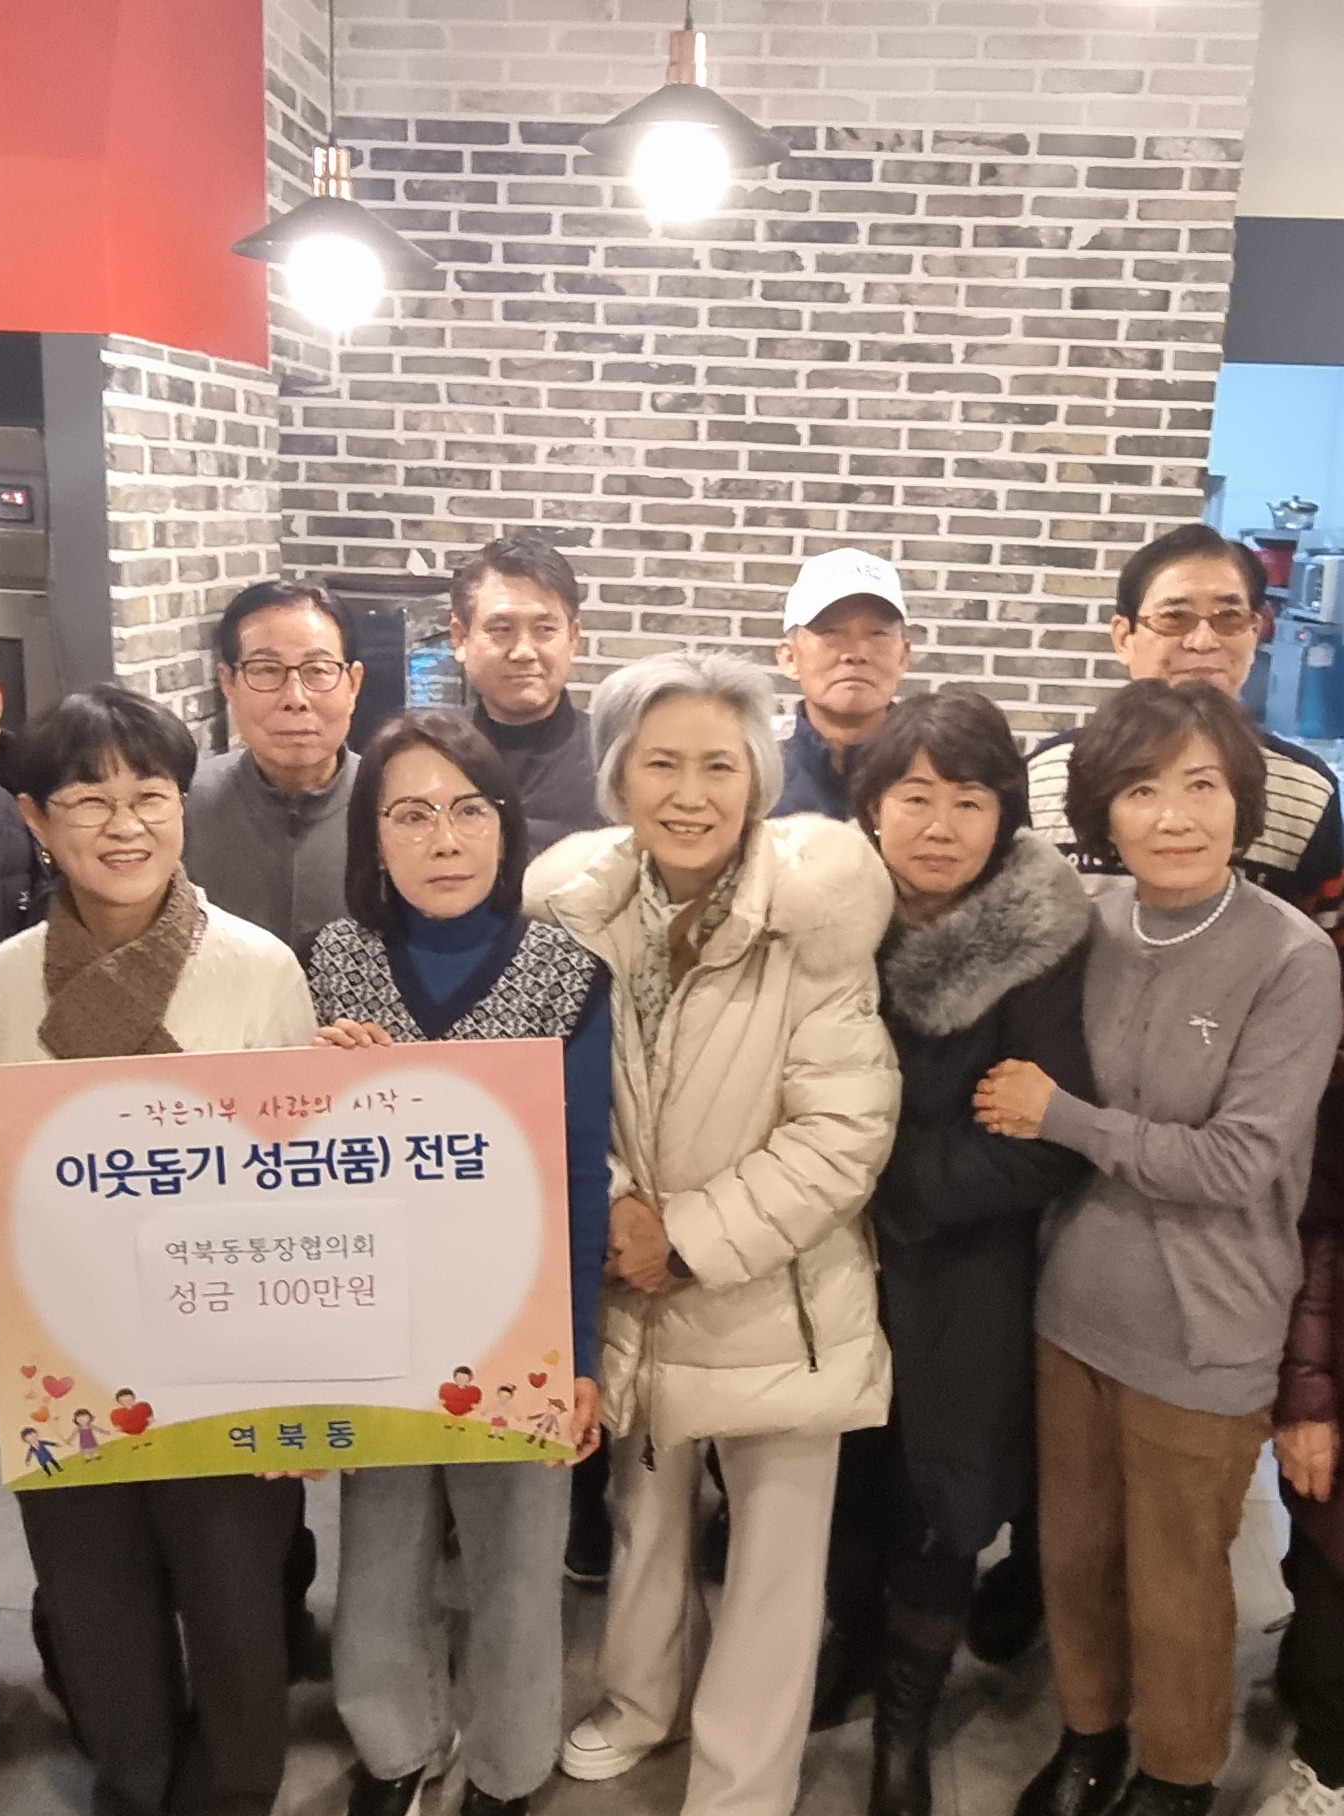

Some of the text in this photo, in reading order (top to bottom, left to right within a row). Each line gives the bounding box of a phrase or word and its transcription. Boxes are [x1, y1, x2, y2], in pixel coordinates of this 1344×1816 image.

[144, 1096, 238, 1127] 작은기부
[257, 1093, 334, 1119] 사랑의
[352, 1088, 400, 1115] 시작
[55, 1132, 490, 1199] 이웃돕기 성금(품) 전달
[164, 1232, 375, 1266] 역북동통장협의회
[169, 1273, 376, 1315] 성금 100만원
